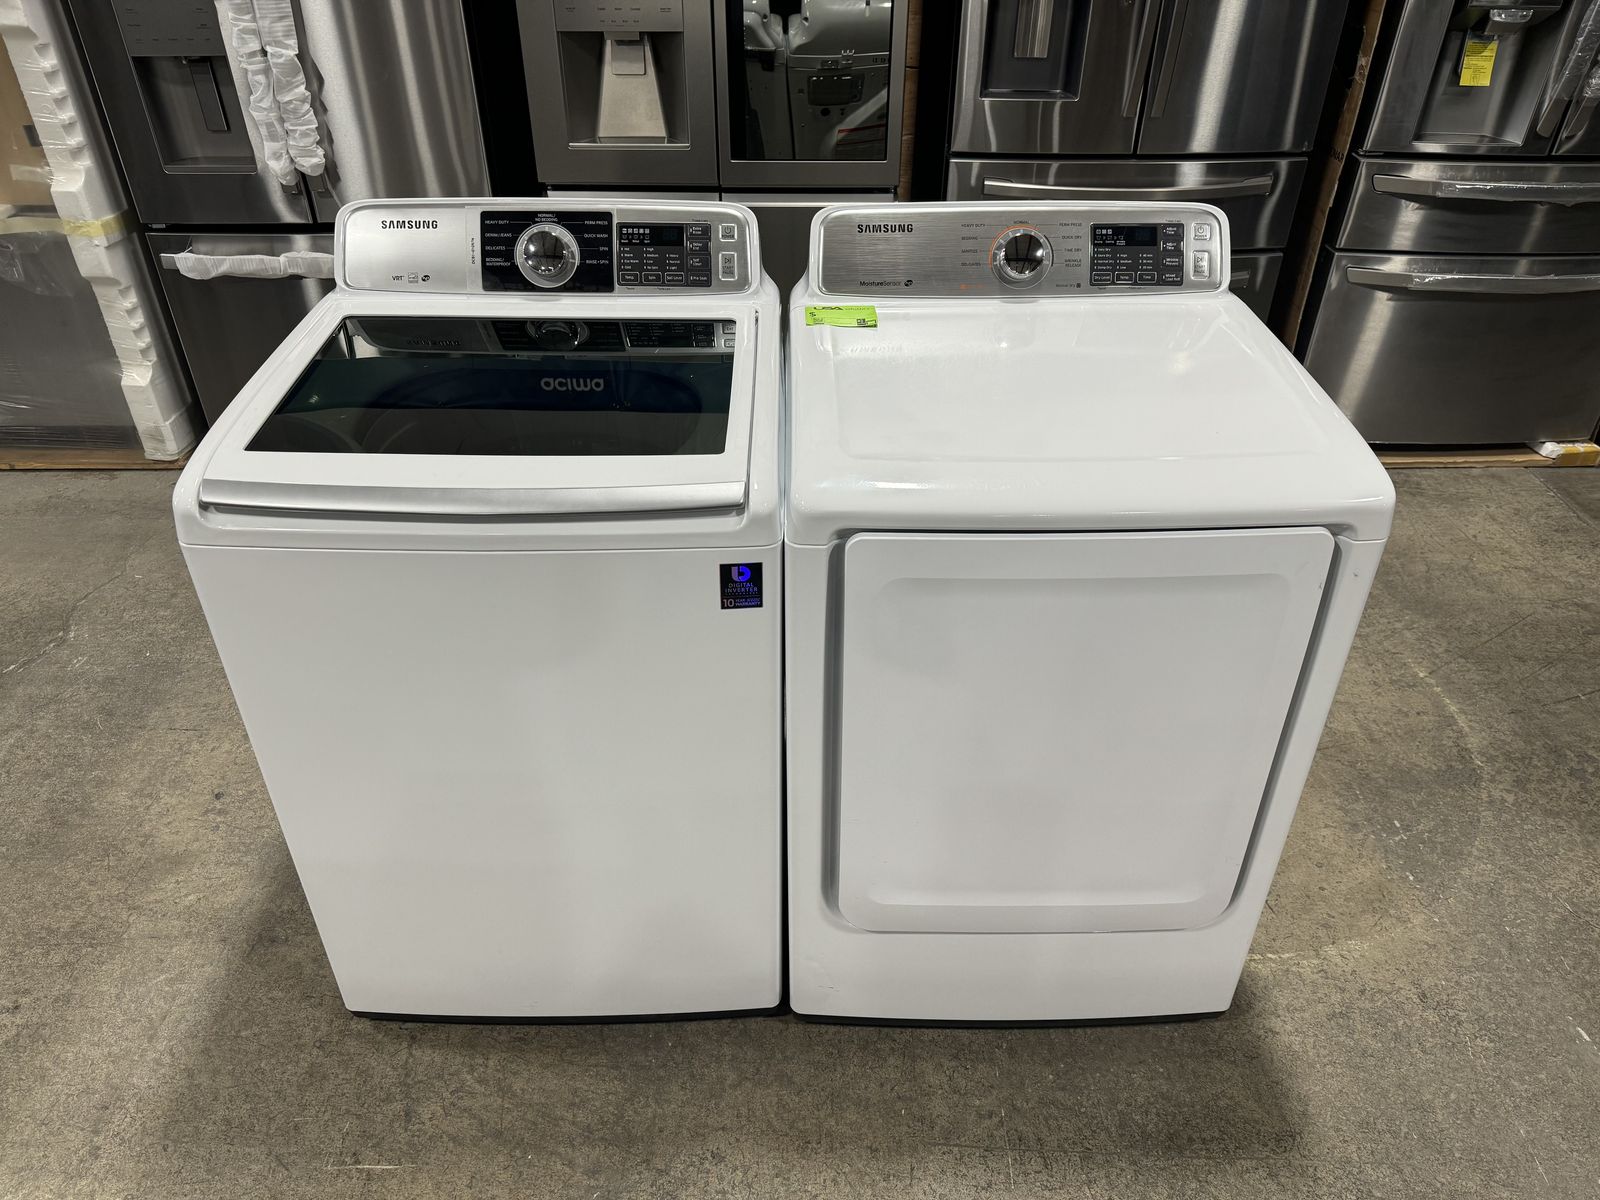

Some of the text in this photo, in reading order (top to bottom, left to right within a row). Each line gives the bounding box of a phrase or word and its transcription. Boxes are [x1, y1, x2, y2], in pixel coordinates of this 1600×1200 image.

[381, 220, 438, 230] SAMSUNG
[857, 223, 913, 233] SAMSUNG
[723, 598, 735, 607] 10
